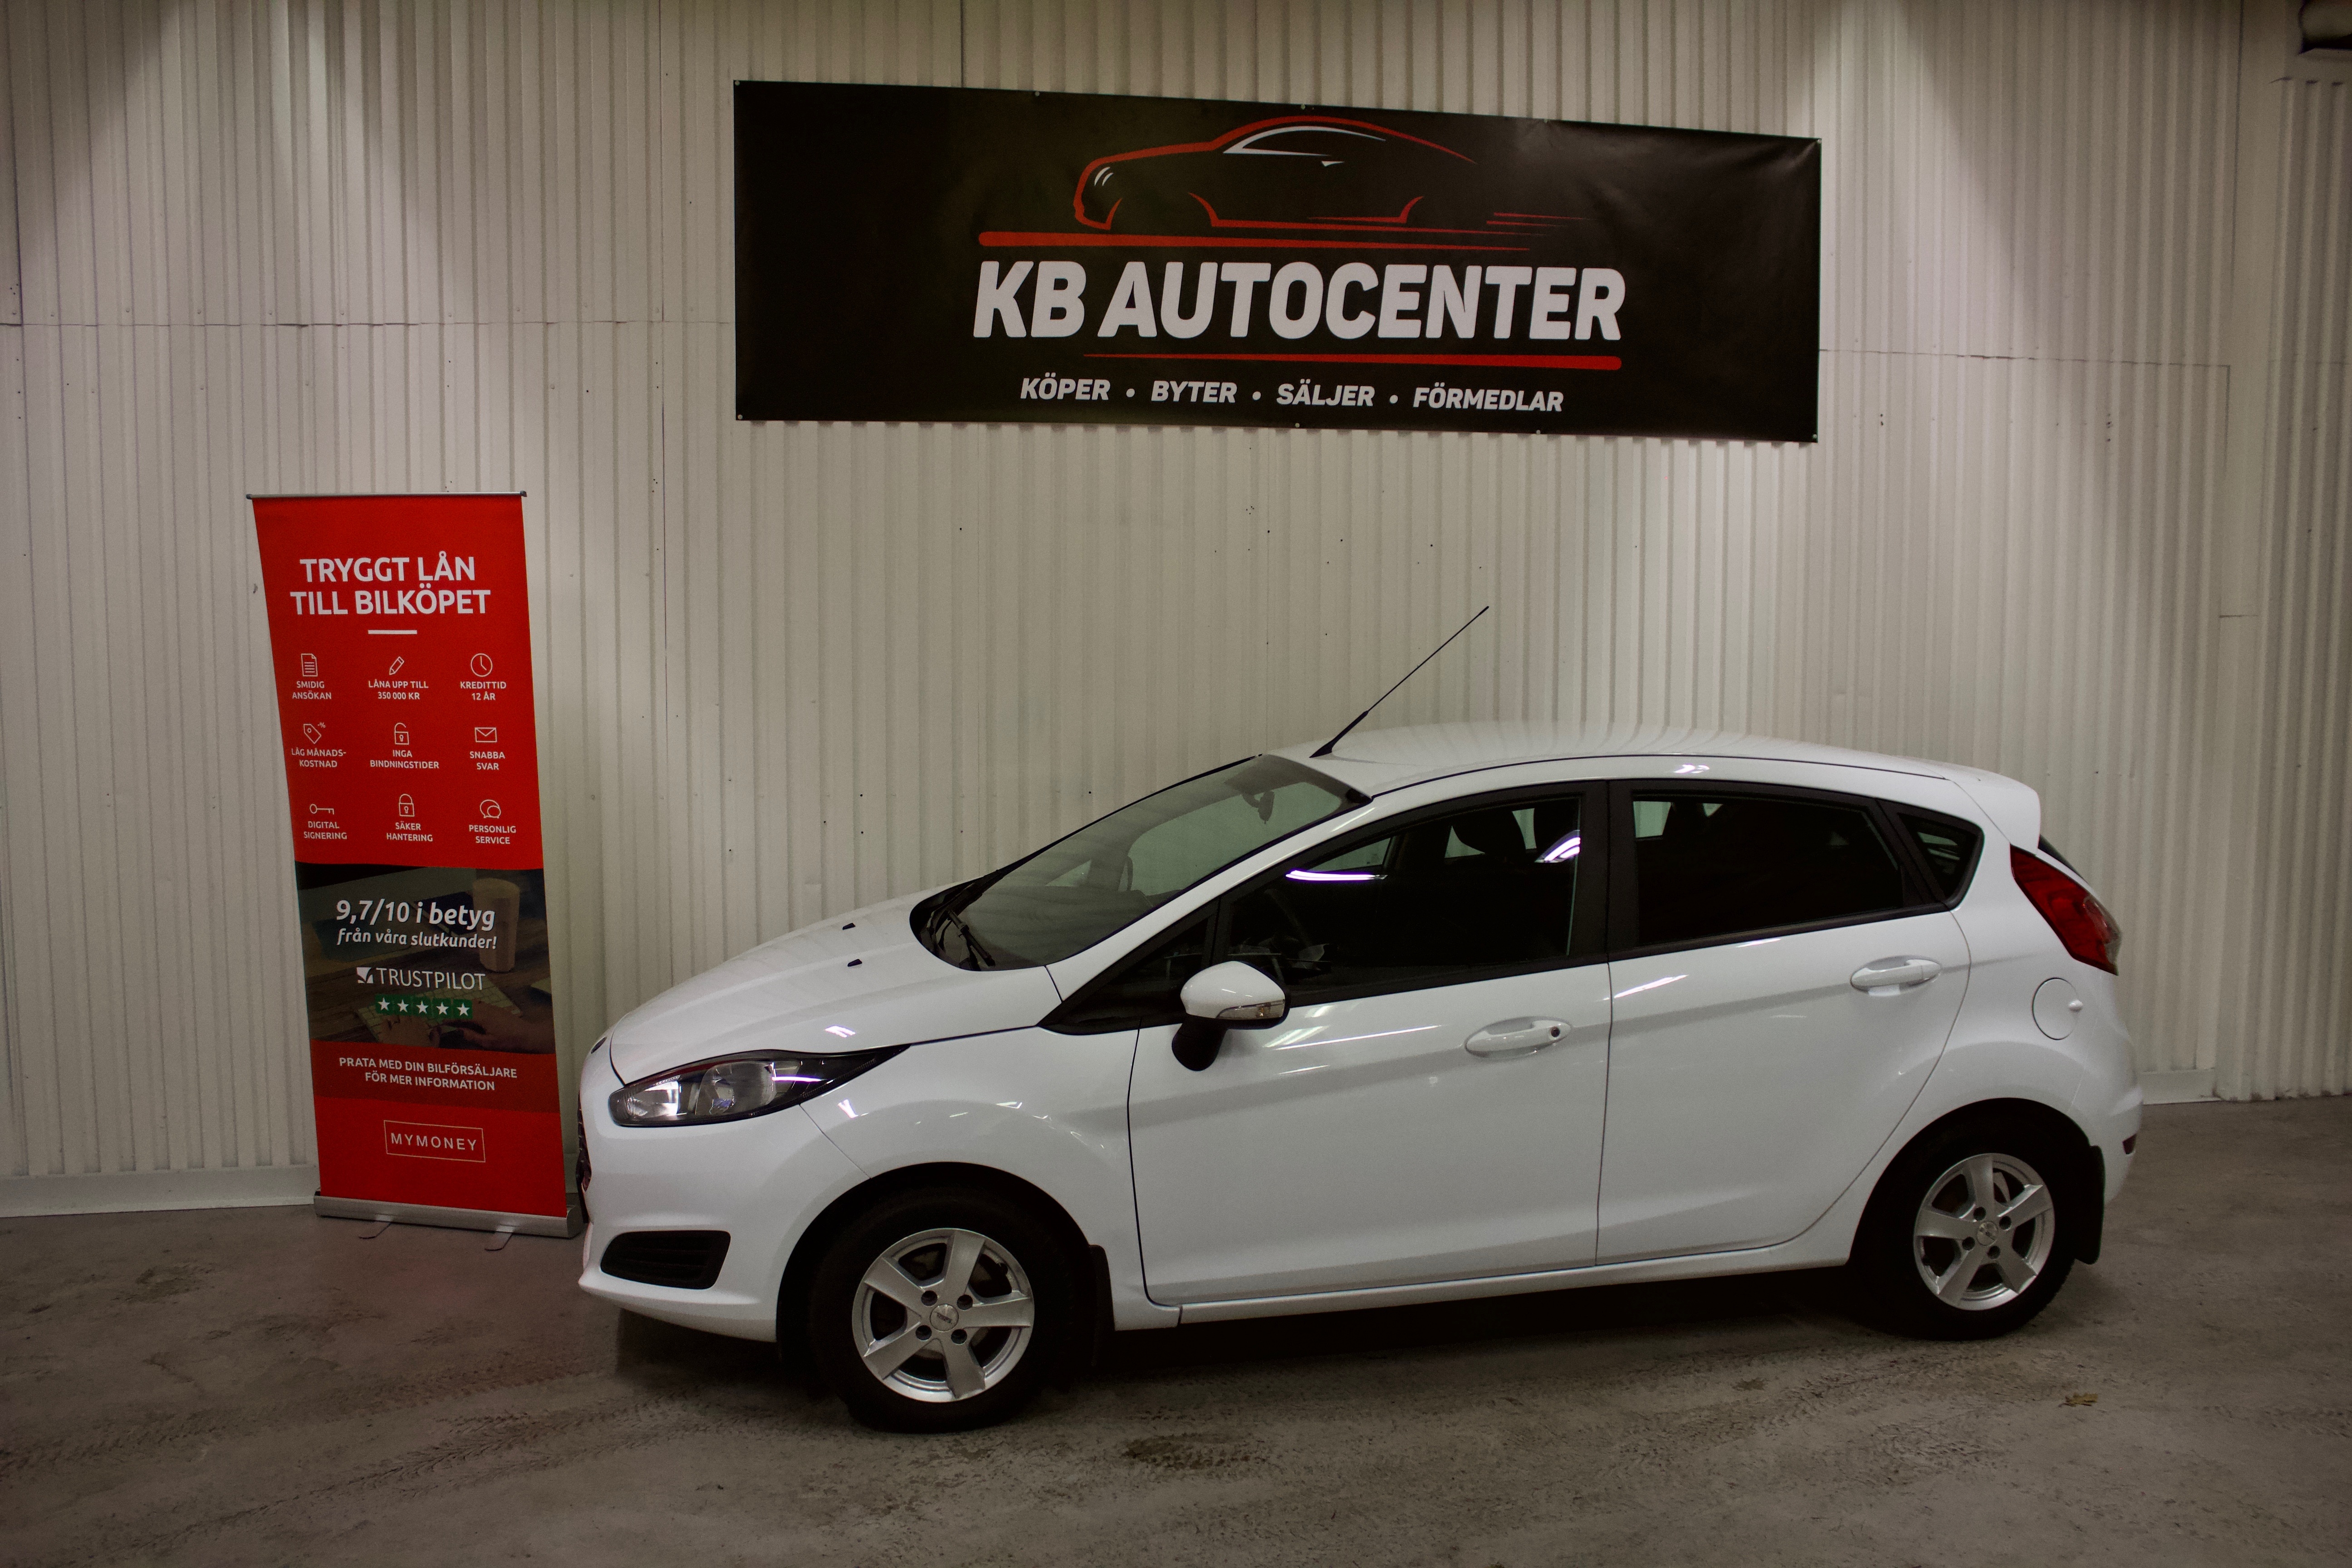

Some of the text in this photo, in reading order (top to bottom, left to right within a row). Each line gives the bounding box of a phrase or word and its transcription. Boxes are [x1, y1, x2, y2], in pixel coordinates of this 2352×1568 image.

[973, 261, 1626, 341] KB AUTOCENTER
[1020, 372, 1564, 412] KÖPER BYTER SÄLJER FÖRMEDLAR
[299, 550, 475, 583] TRYGGT LÅN
[290, 583, 491, 615] TILL BILKÖPET
[296, 681, 325, 689] SMIDIG
[368, 679, 391, 688] LÅNA
[410, 681, 429, 689] TILL
[460, 681, 507, 689] KREDITTID
[292, 690, 332, 700] ANSÖKAN
[471, 691, 495, 701] 12 ÅR
[291, 747, 346, 757] LÅG MÅNADS-
[392, 750, 412, 758] INGA
[470, 751, 505, 759] SNABBA
[299, 760, 338, 768] KOSTNAD
[370, 760, 439, 769] BINDNINGSTIDER
[476, 762, 499, 770] SVAR
[308, 821, 340, 829] DIGITAL
[395, 821, 421, 831] SÄKER
[469, 824, 516, 833] PERSONLIG
[304, 831, 347, 839] SIGNERING
[386, 833, 433, 842] HANTERING
[475, 836, 510, 844] SERVICE
[337, 898, 495, 931] 9,7/10 i betyg
[337, 927, 497, 950] från våra slutkunder!
[376, 967, 486, 990] TRUSTPILOT
[339, 1057, 517, 1078] PRATA MED DIN BILFÖRSÄLJARE
[365, 1070, 495, 1091] FÖR MER INFORMATION
[391, 1132, 476, 1151] MYMONEY
